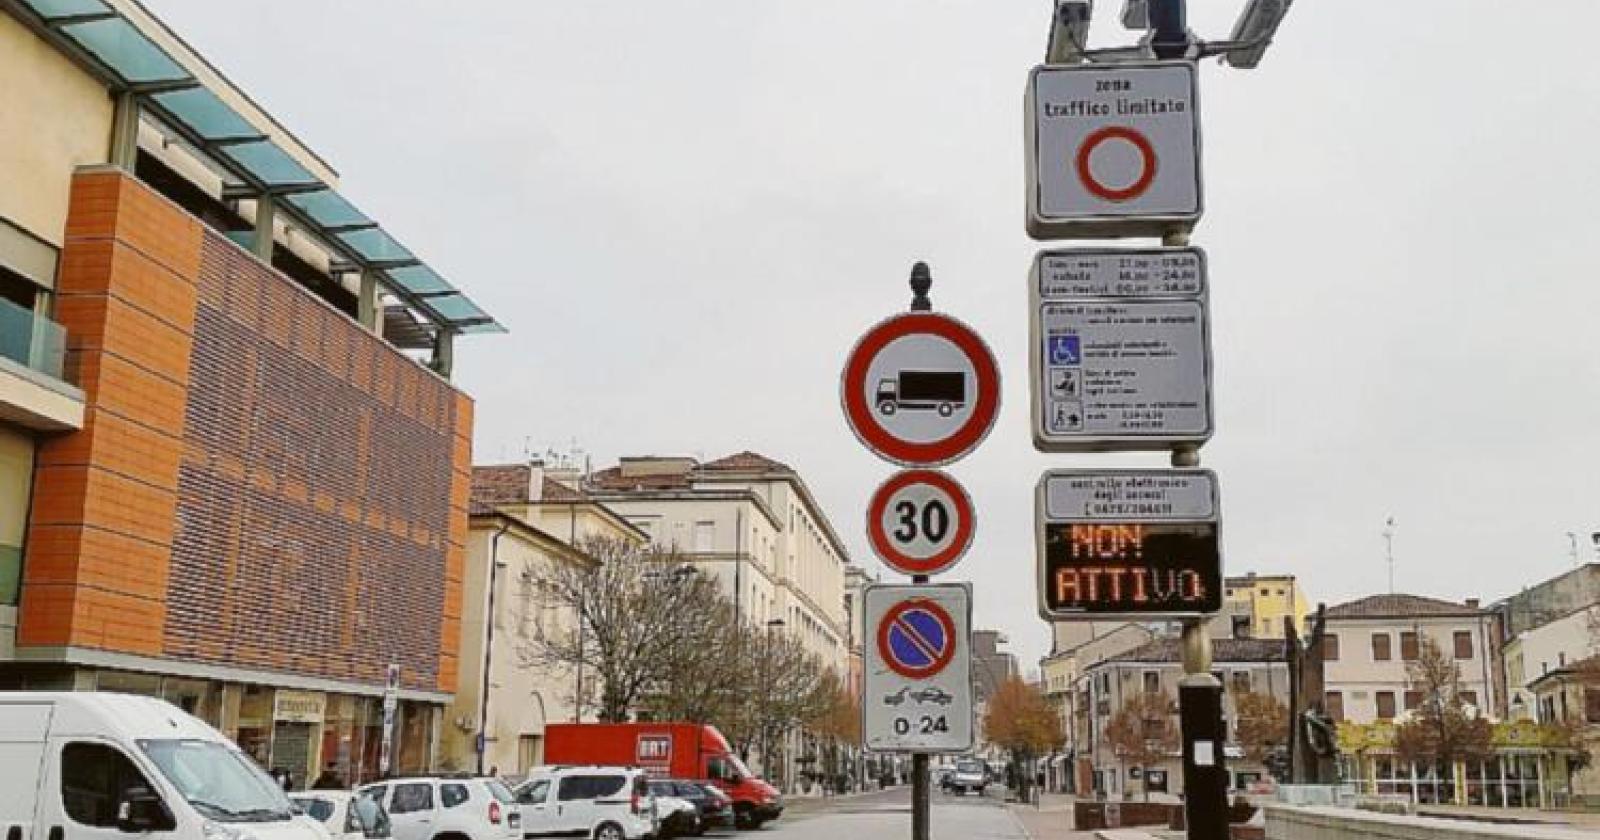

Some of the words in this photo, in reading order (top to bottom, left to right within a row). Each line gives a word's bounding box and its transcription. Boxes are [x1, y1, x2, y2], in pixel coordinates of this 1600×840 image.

[1096, 79, 1132, 92] zona
[1044, 100, 1110, 116] traffico
[1117, 98, 1185, 115] limitato
[893, 499, 949, 544] 30
[1072, 523, 1142, 559] NON
[1056, 567, 1201, 602] ATTIVO
